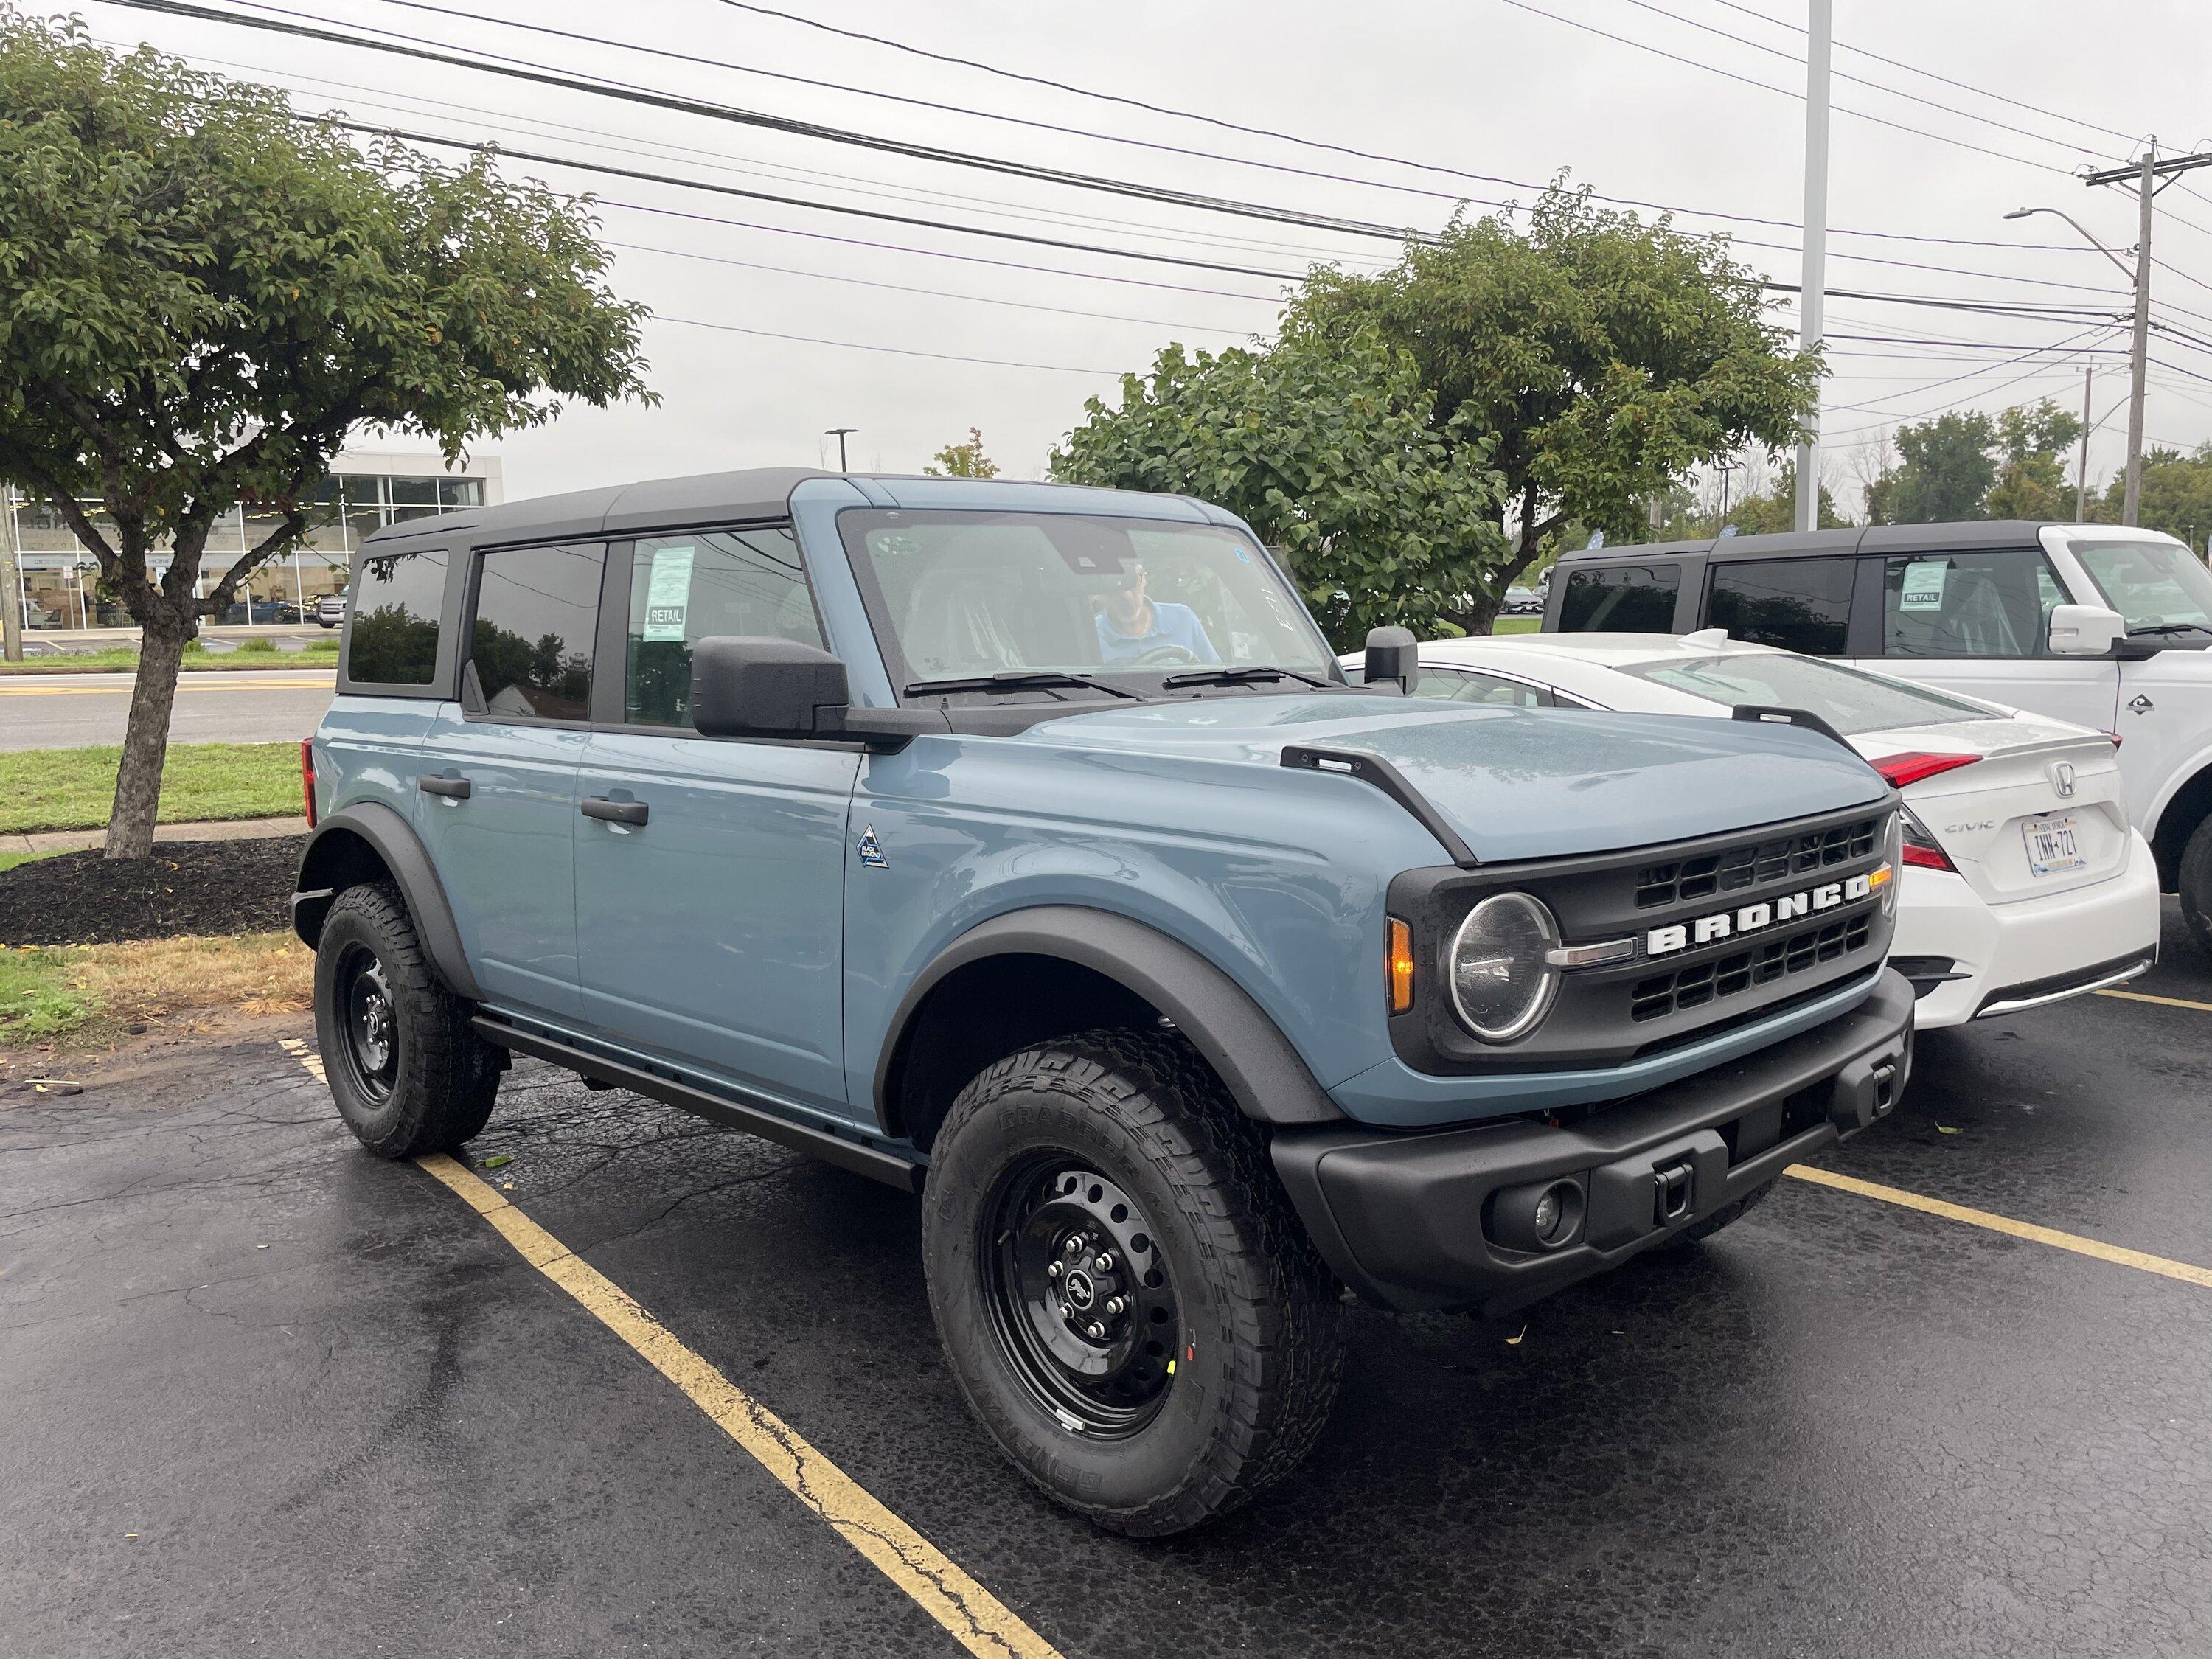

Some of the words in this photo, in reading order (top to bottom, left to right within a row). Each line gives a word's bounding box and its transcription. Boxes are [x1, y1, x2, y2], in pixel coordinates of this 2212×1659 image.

[1906, 594, 1937, 602] RETAIL
[651, 609, 681, 622] RETAIL
[1944, 820, 1994, 833] CIVIC
[2038, 823, 2051, 832] NEW
[2051, 820, 2066, 831] YORK
[1647, 874, 1871, 956] BRONCO
[998, 1105, 1140, 1178] GRABBER
